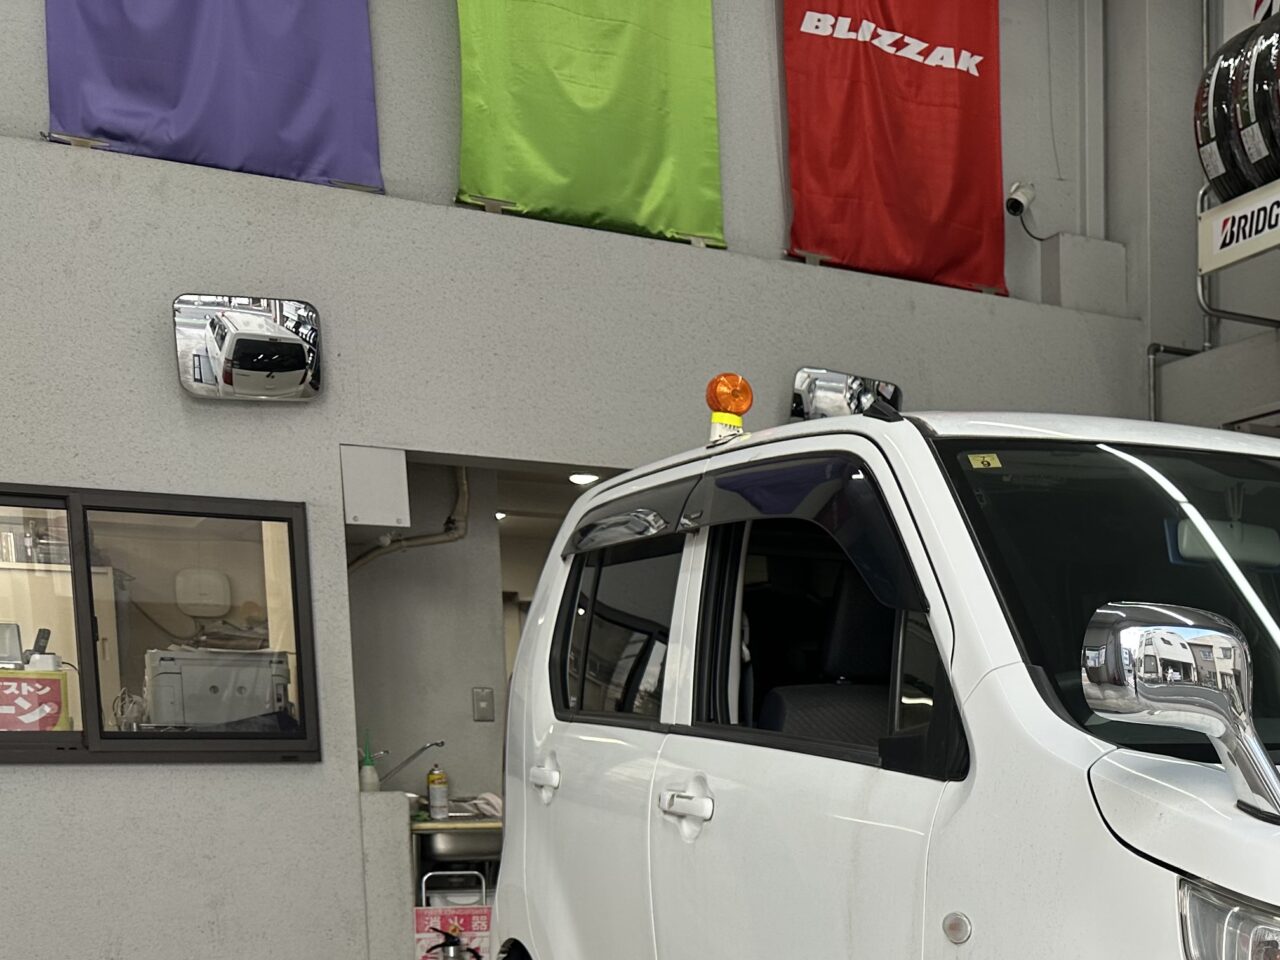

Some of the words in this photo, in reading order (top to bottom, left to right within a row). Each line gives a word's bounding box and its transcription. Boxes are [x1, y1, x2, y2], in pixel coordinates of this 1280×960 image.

[800, 11, 985, 77] BLIZZAK
[0, 681, 52, 696] ストン
